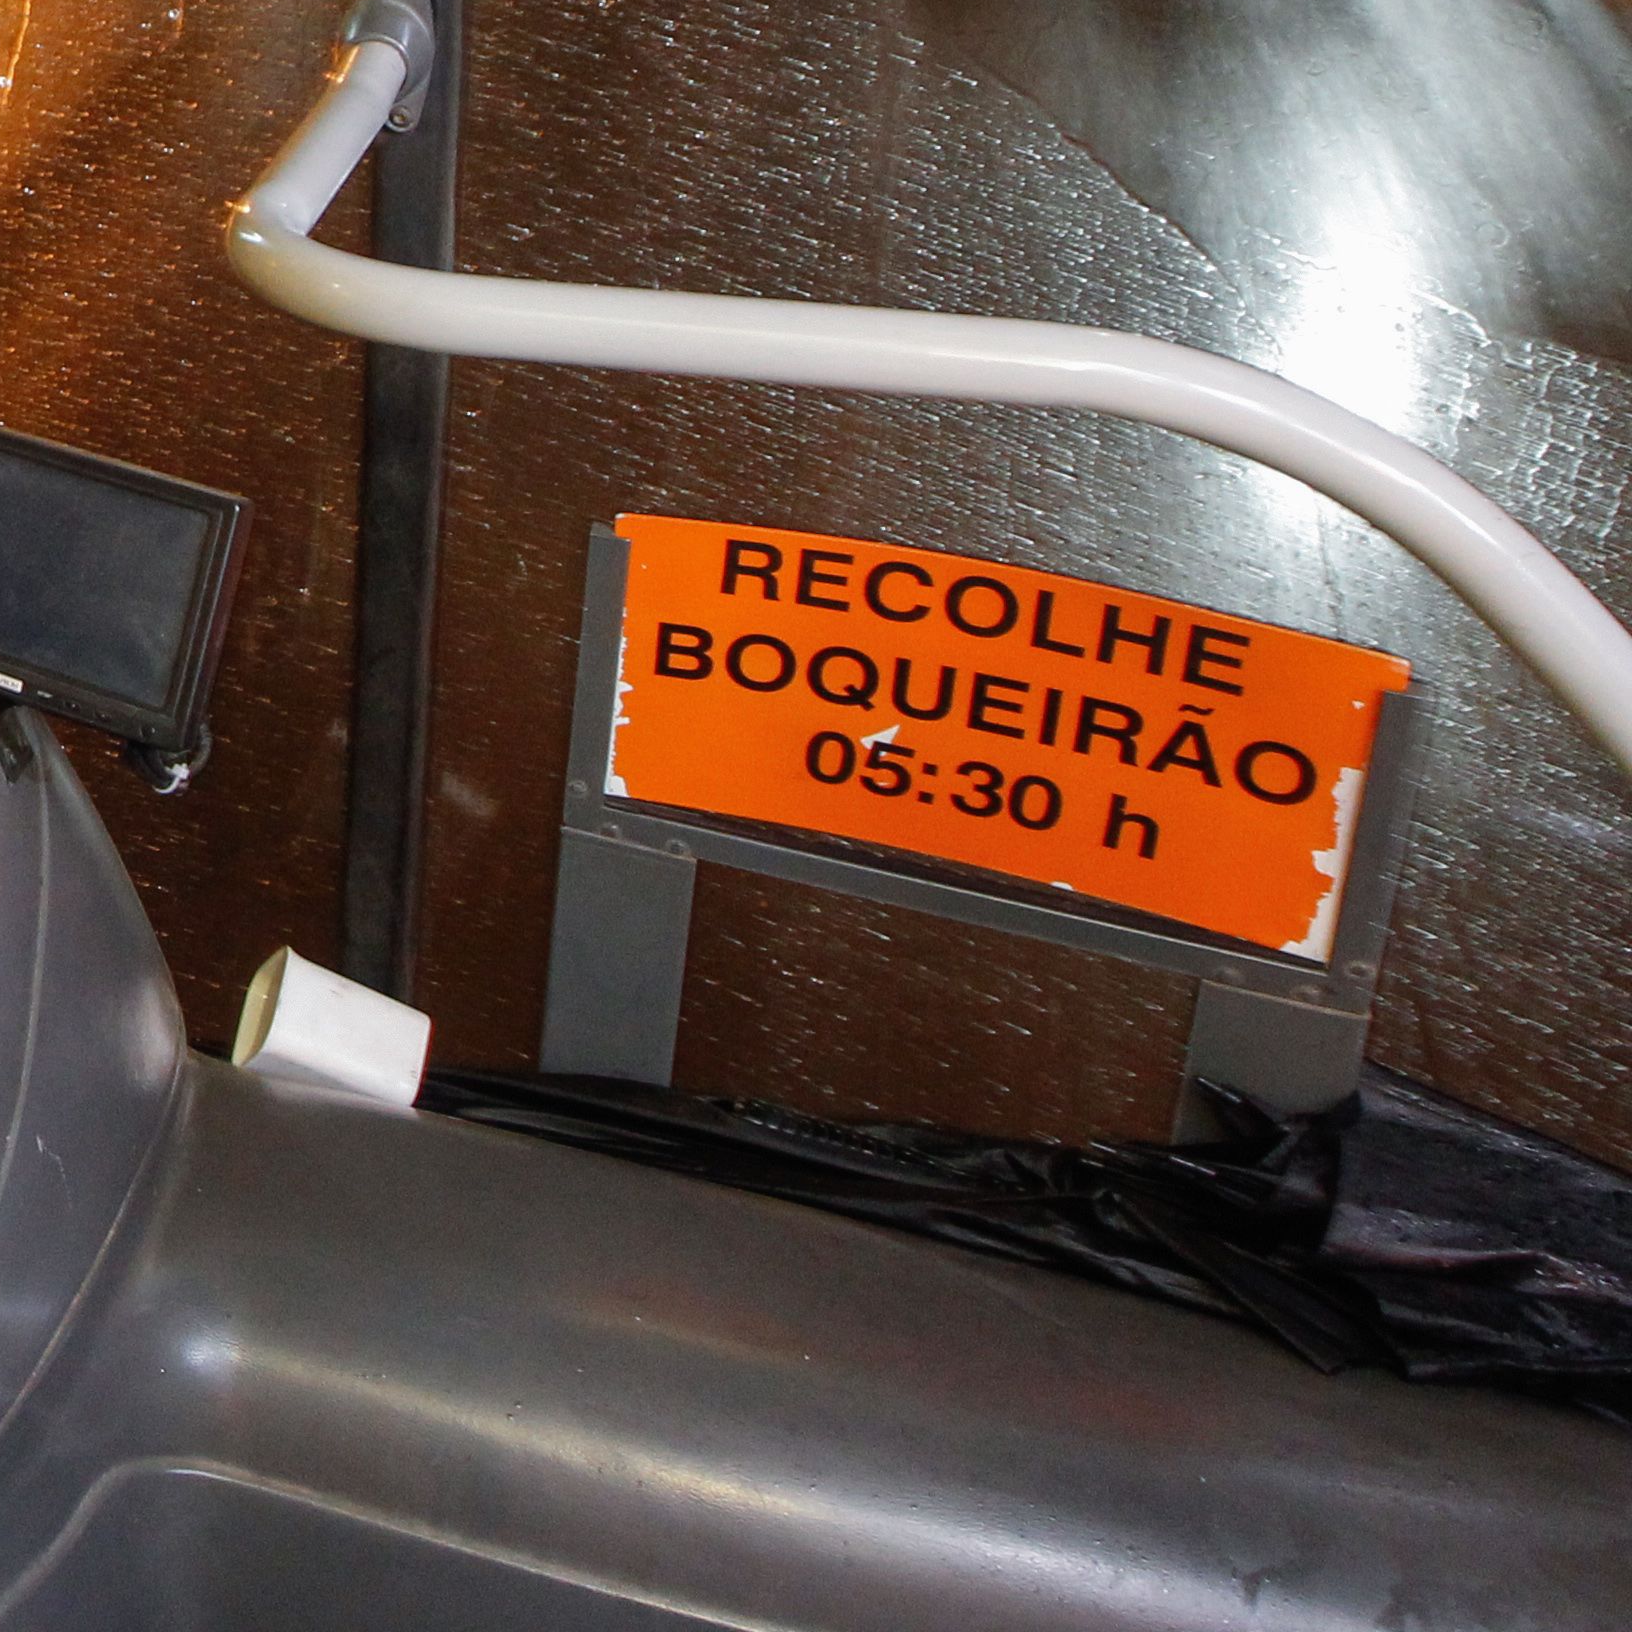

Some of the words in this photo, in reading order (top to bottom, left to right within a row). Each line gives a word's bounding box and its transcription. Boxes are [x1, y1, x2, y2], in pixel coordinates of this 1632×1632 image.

[719, 538, 1252, 697] RECOLHE
[654, 621, 1319, 806] BOQUEIRÃO
[804, 731, 1063, 832] 05:30
[1102, 796, 1160, 861] h
